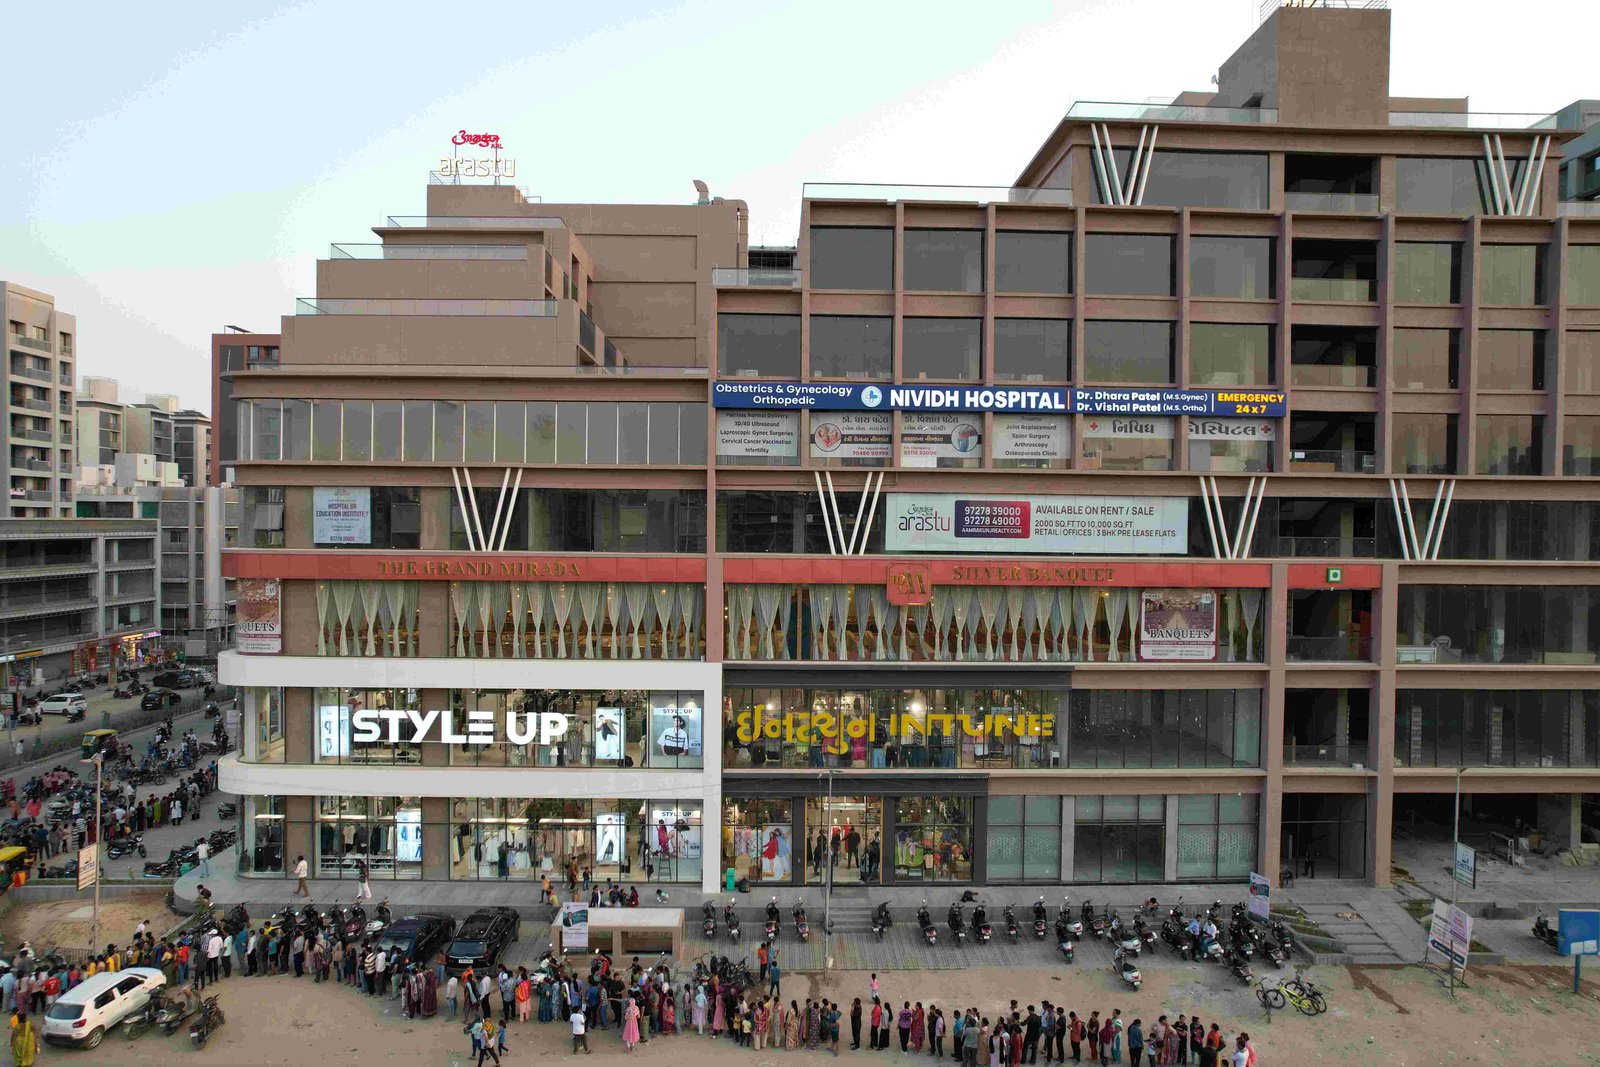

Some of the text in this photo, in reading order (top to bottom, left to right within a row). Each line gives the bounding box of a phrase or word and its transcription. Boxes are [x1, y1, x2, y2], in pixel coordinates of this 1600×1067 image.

[440, 157, 516, 178] arastu
[716, 384, 853, 396] Obstetrics & Gynecology
[753, 395, 816, 406] Orthopedic
[890, 389, 1065, 409] NIVIDH HOSPITAL
[1076, 391, 1093, 401] Dr.
[1095, 391, 1130, 401] Dhara
[1132, 392, 1160, 402] Patel
[1218, 393, 1284, 403] EMERGENCY
[1076, 402, 1093, 411] Dr.
[1095, 402, 1130, 412] Vishal
[1132, 403, 1161, 412] Patel
[1236, 405, 1250, 414] 24
[1260, 405, 1267, 414] 7
[1112, 419, 1155, 434] નિવિધ
[964, 506, 1021, 516] 97278 39000
[1035, 505, 1083, 515] AVAILABLE
[1084, 506, 1099, 515] ON
[1100, 506, 1124, 516] RENT
[1132, 506, 1154, 516] SALE
[898, 511, 951, 531] arastu
[964, 516, 1021, 526] 97278 49000
[1034, 520, 1054, 528] 2000
[1076, 520, 1086, 528] TO
[1034, 528, 1058, 536] RETAIL
[1132, 530, 1154, 538] LEASE
[1155, 530, 1176, 538] FLATS
[378, 560, 581, 578] THE GRAND MIRADA
[953, 566, 1116, 583] SILVER BANQUET
[237, 622, 275, 632] NQUETS
[1150, 629, 1210, 640] BANQUETS
[352, 709, 569, 746] STYLE UP
[890, 713, 1054, 738] INTUNE
